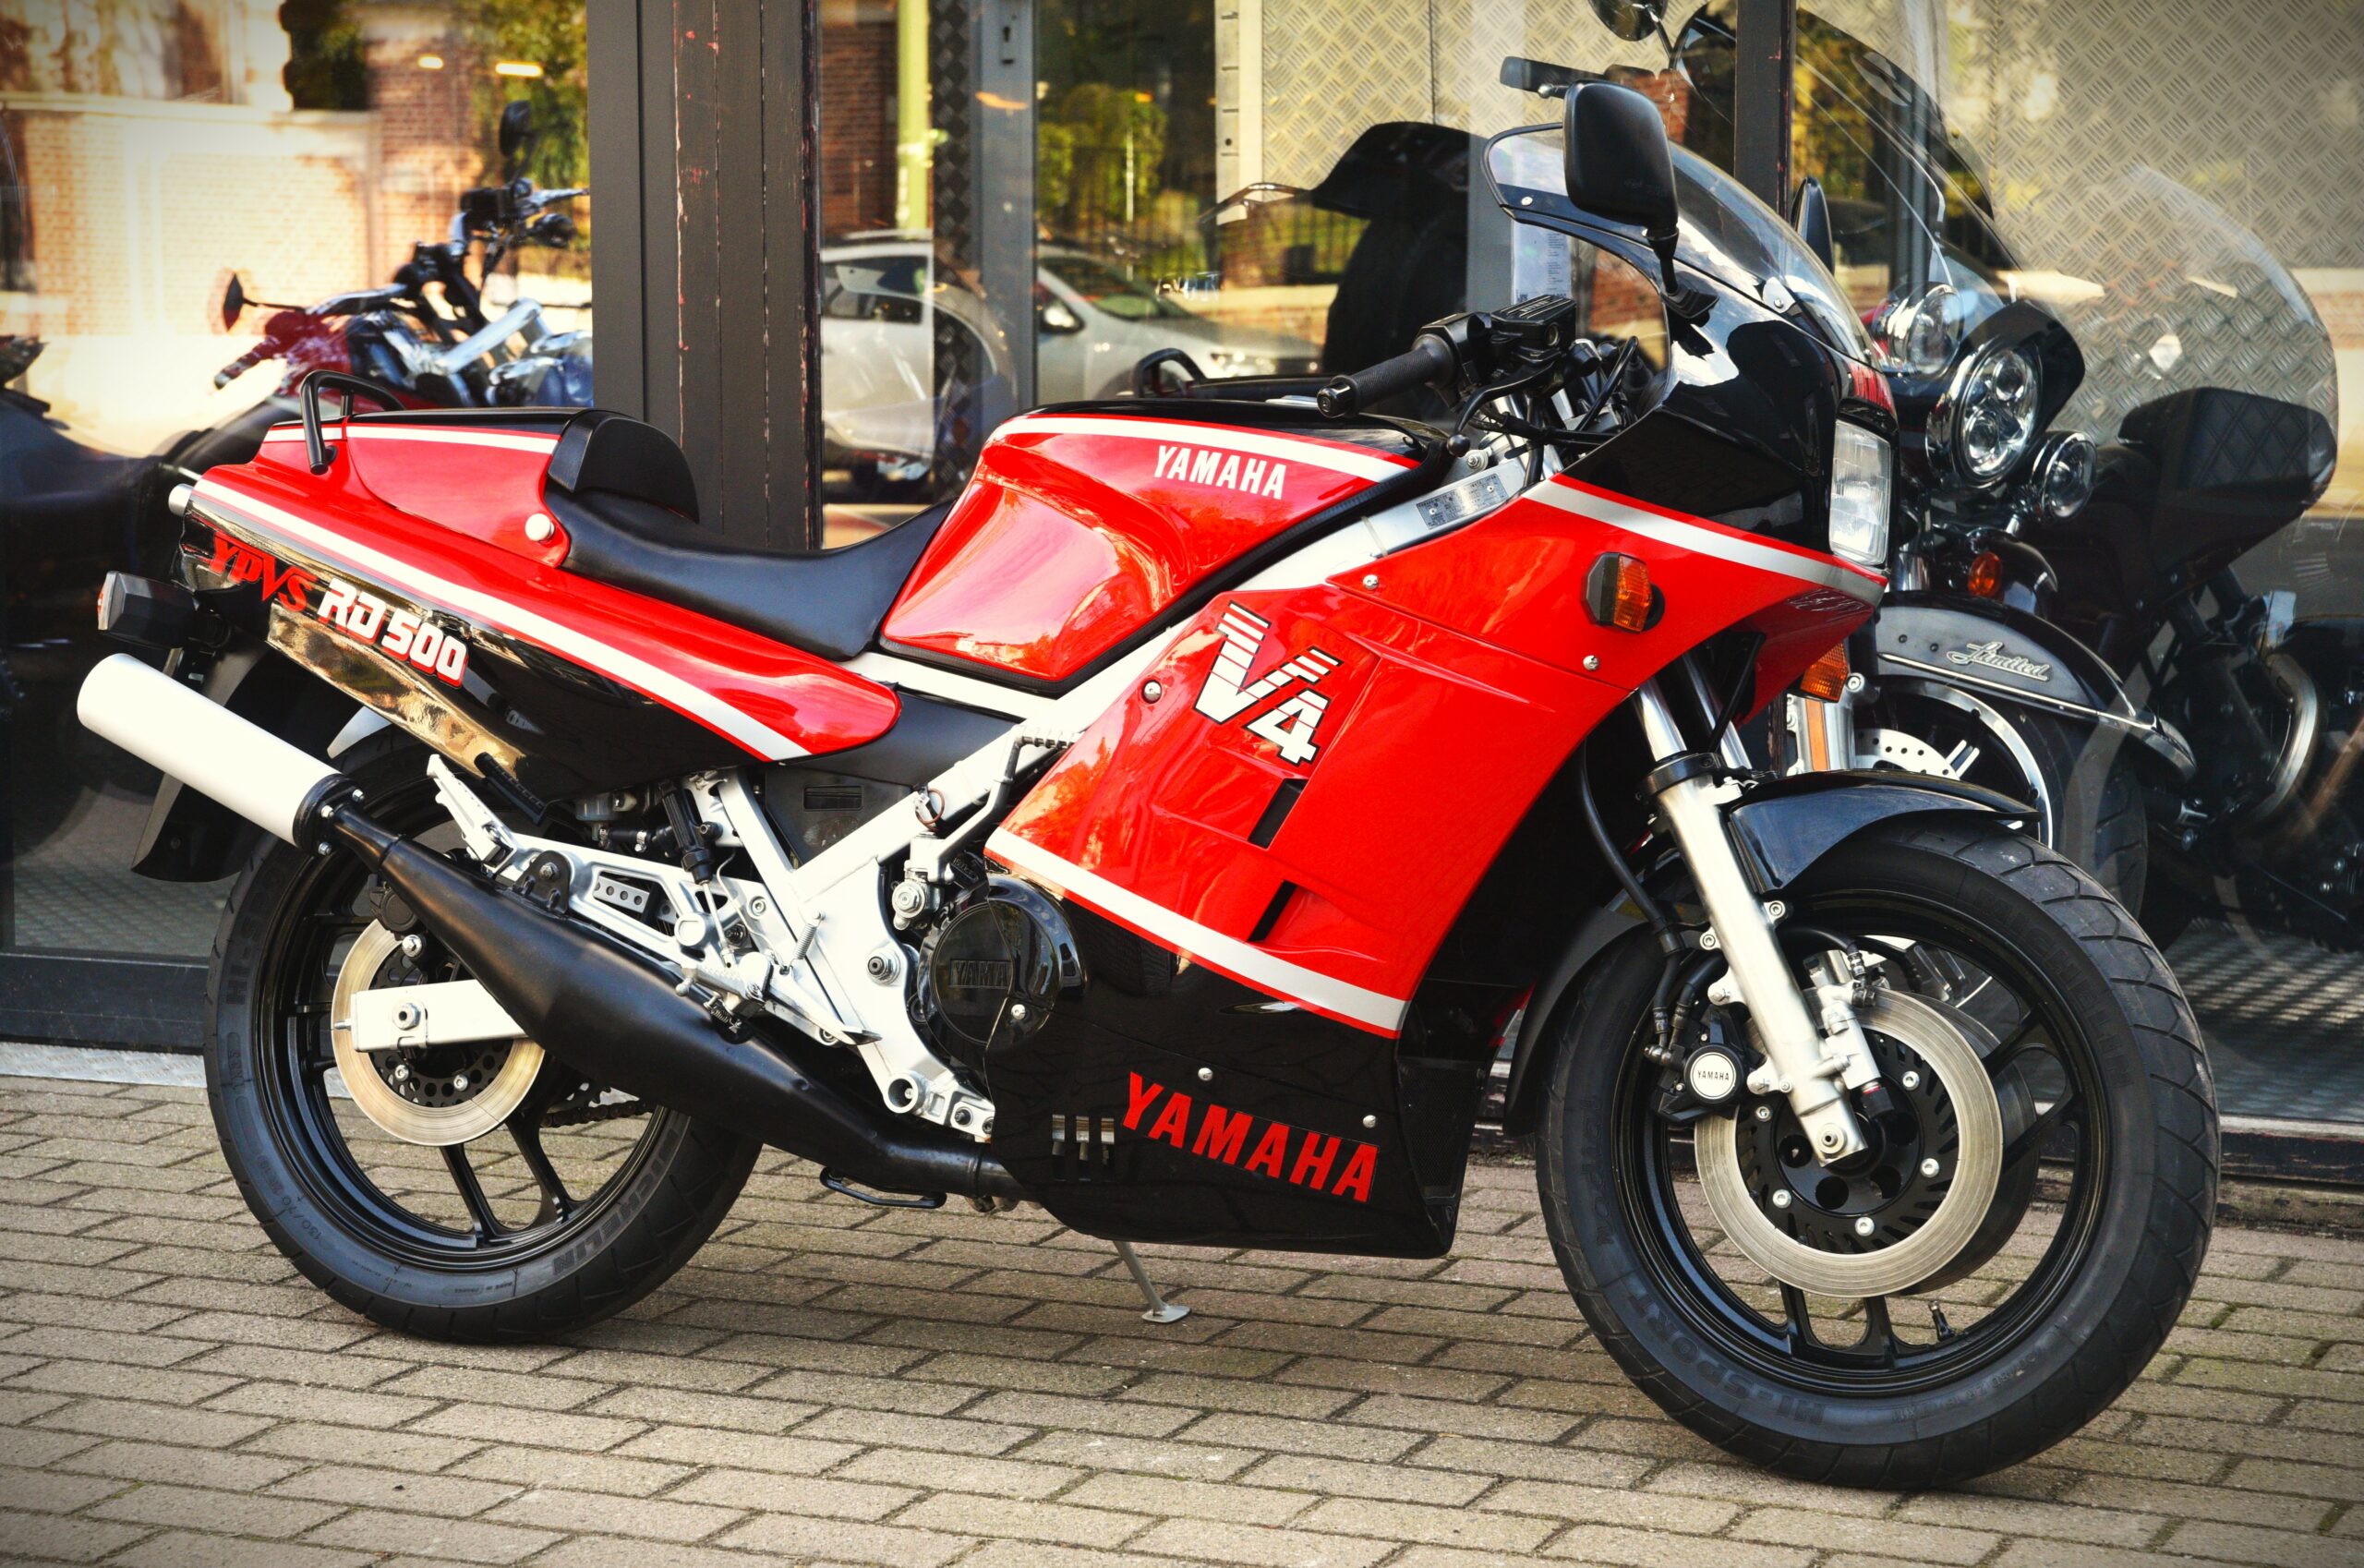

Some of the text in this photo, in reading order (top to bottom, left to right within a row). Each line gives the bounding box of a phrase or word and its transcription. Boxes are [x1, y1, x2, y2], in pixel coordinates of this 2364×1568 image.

[1154, 445, 1286, 500] YAMAHA
[210, 532, 469, 687] YPVS RD 500
[1946, 642, 2051, 681] Limited
[1193, 600, 1344, 766] V4
[955, 960, 1012, 986] YAMA
[1123, 1072, 1378, 1202] YAMAHA
[1697, 1069, 1730, 1081] YAMAHA
[549, 1128, 680, 1275] MICHELIN
[1627, 1288, 1825, 1425] HI-SPORT
